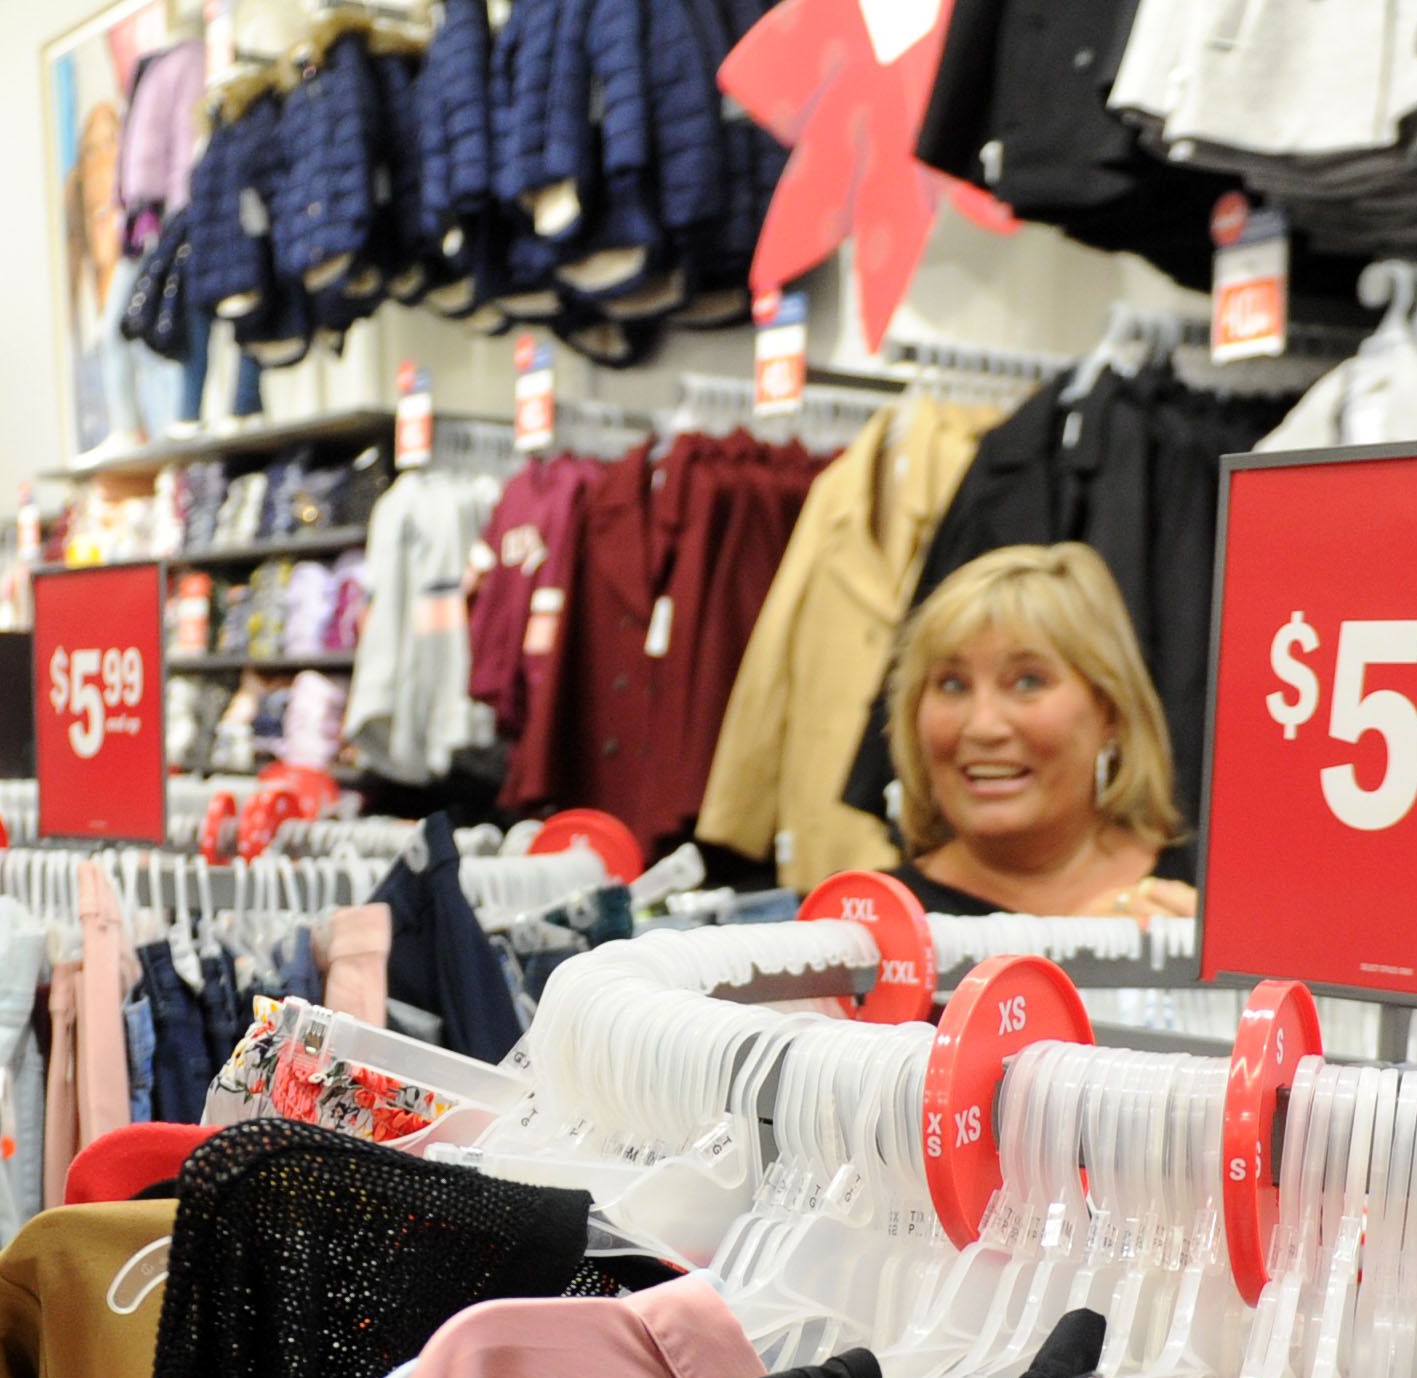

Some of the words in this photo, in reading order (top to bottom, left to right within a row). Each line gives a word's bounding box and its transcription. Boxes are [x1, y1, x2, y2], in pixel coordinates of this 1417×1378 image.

[841, 897, 879, 922] XXL
[881, 960, 920, 984] XXL
[998, 996, 1026, 1036] XS
[1276, 1028, 1284, 1065] S
[955, 1105, 981, 1149] XS
[1229, 1157, 1246, 1181] S
